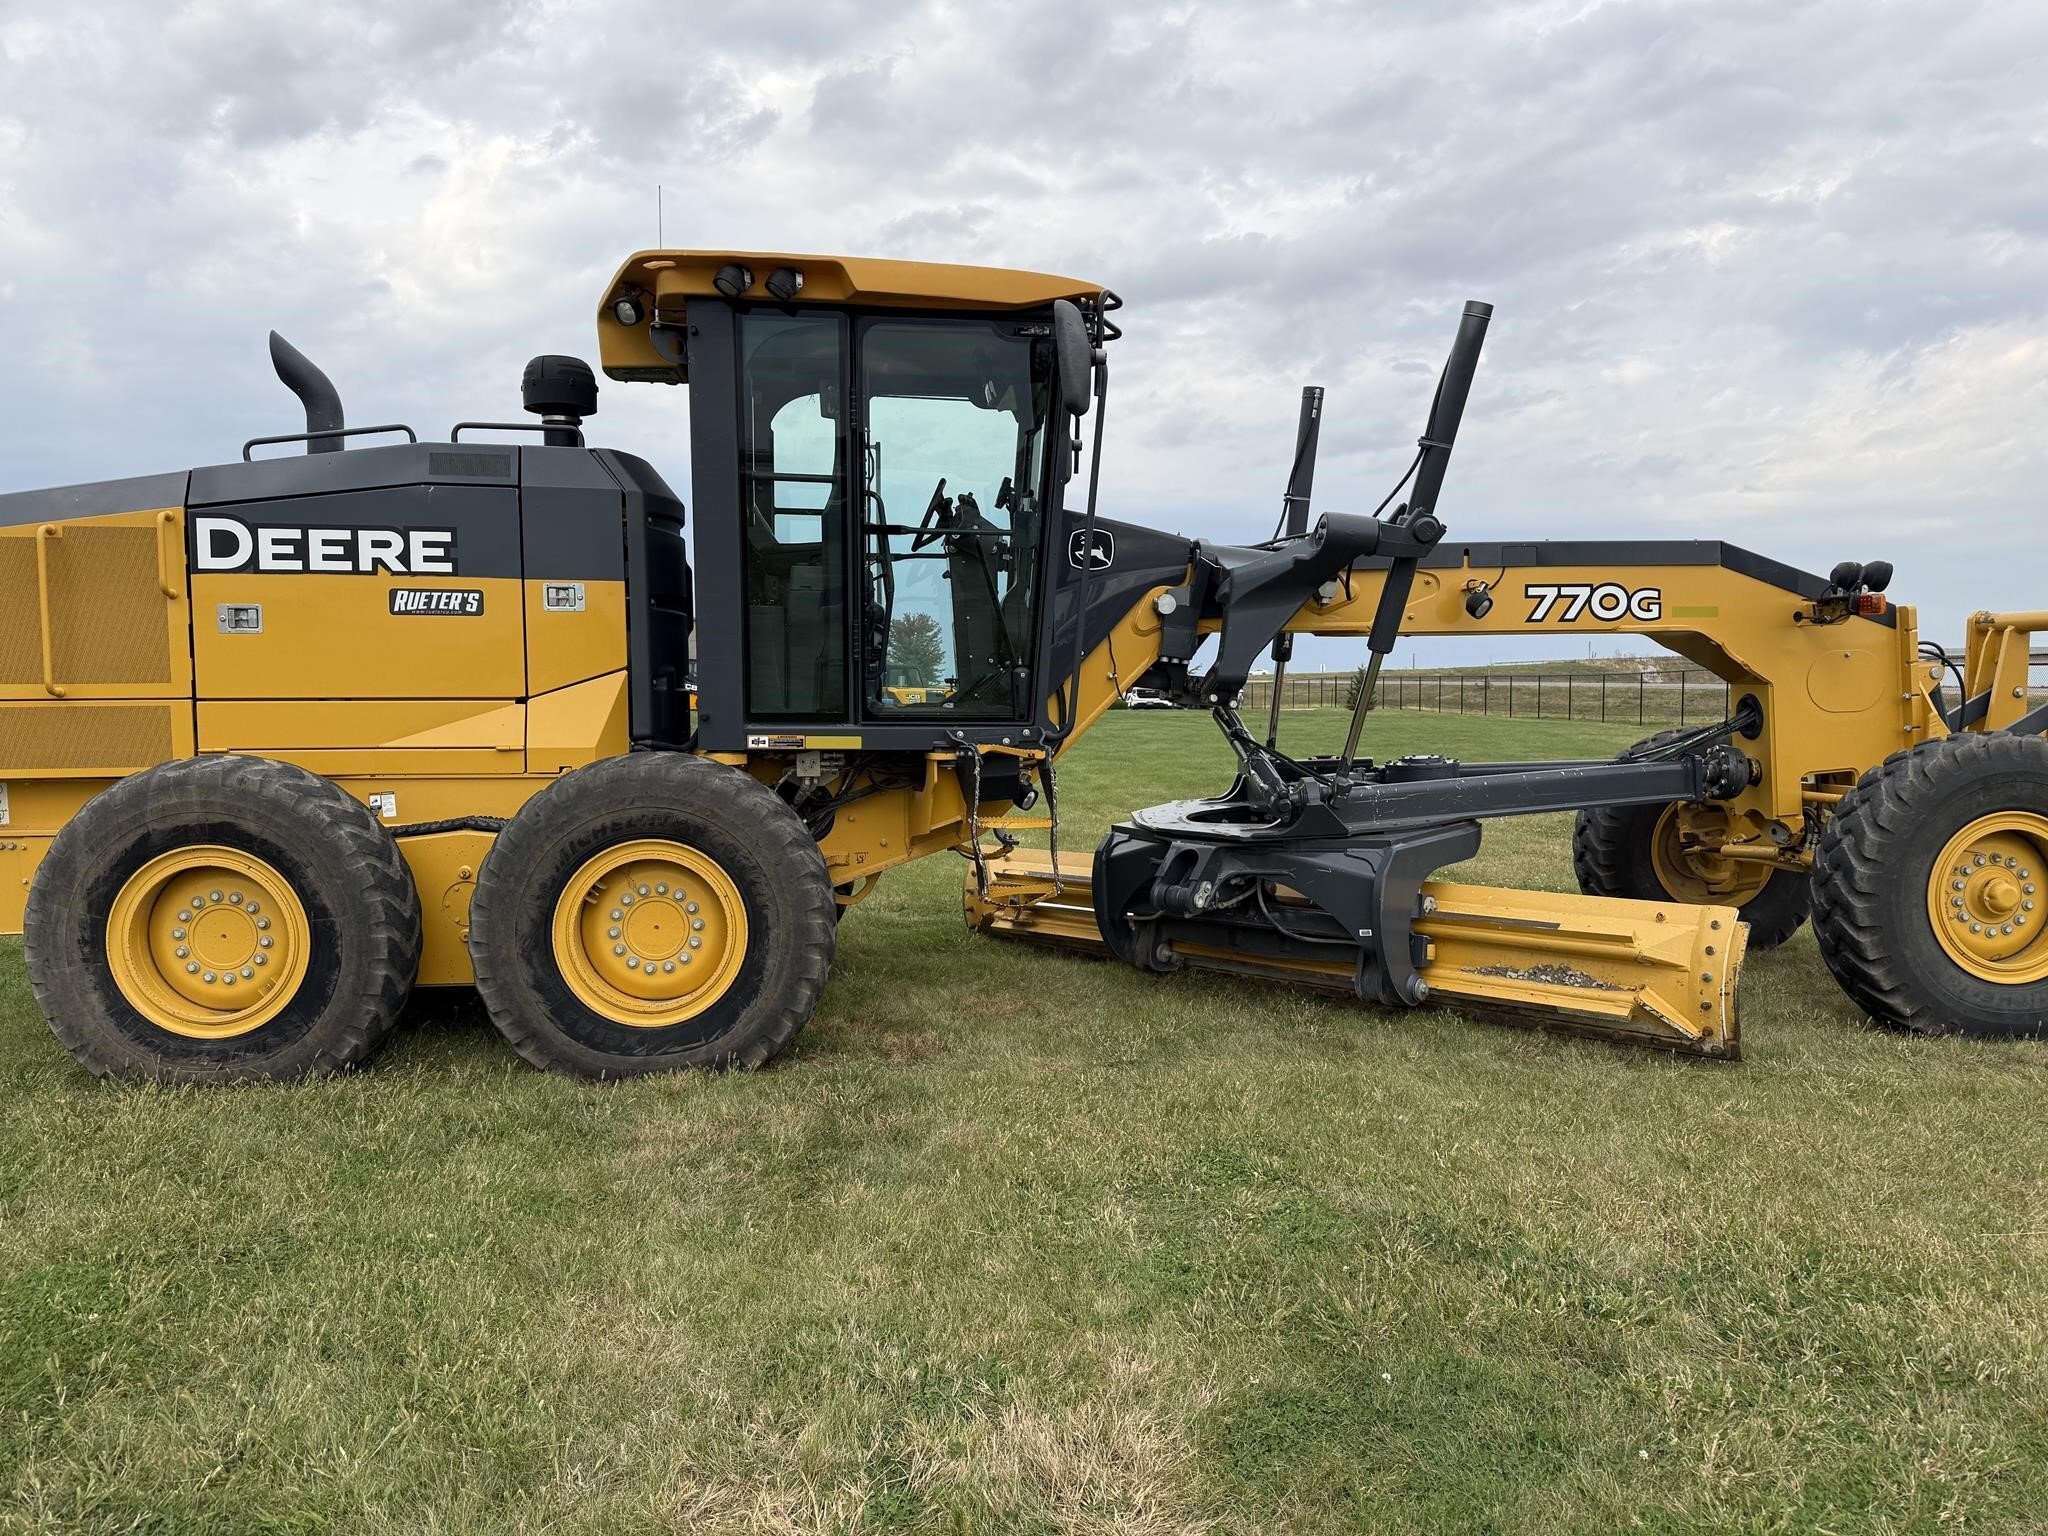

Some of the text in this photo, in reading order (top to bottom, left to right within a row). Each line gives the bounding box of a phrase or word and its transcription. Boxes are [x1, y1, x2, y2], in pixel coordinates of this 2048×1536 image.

[195, 517, 453, 573] DEERE
[393, 590, 480, 612] RUETER'S
[1525, 583, 1662, 622] 770G
